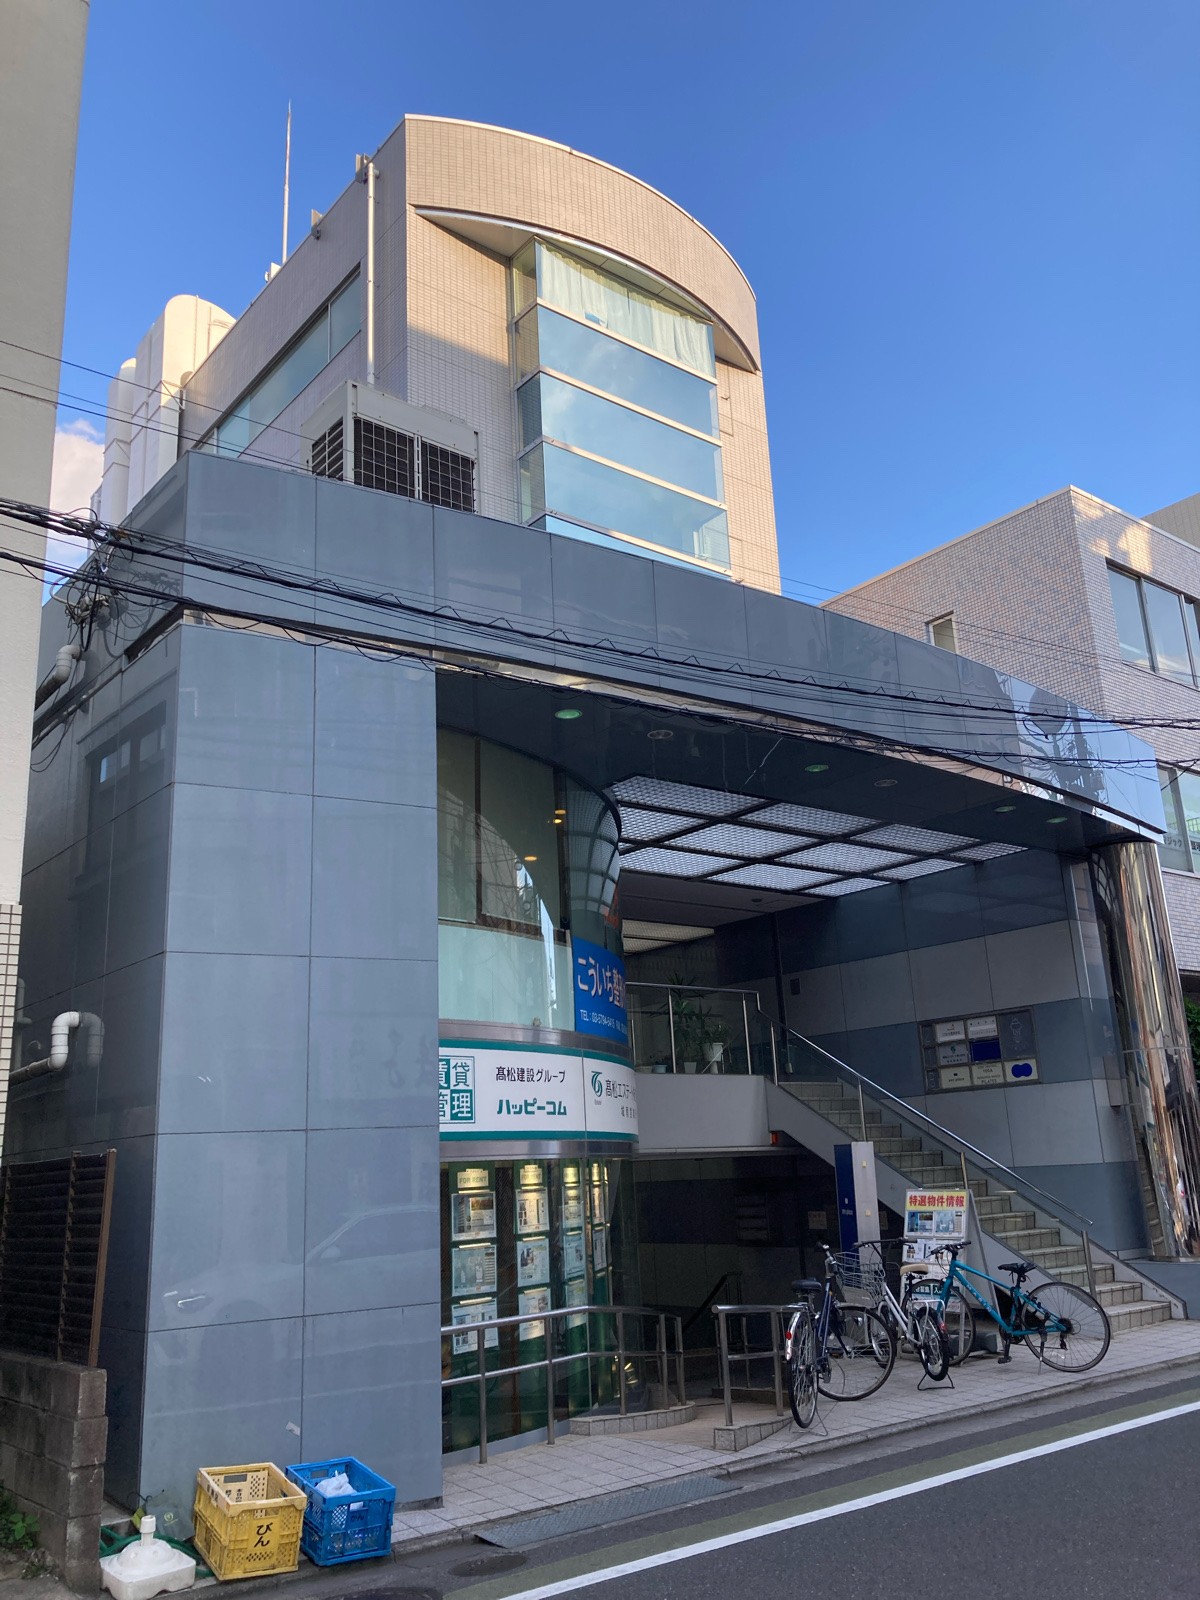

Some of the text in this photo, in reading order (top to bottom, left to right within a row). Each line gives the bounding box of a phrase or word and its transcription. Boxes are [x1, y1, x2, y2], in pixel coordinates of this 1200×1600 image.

[497, 1098, 567, 1116] ハッピーコム
[909, 1195, 965, 1207] 特選物件情報
[254, 1522, 273, 1548] びん
